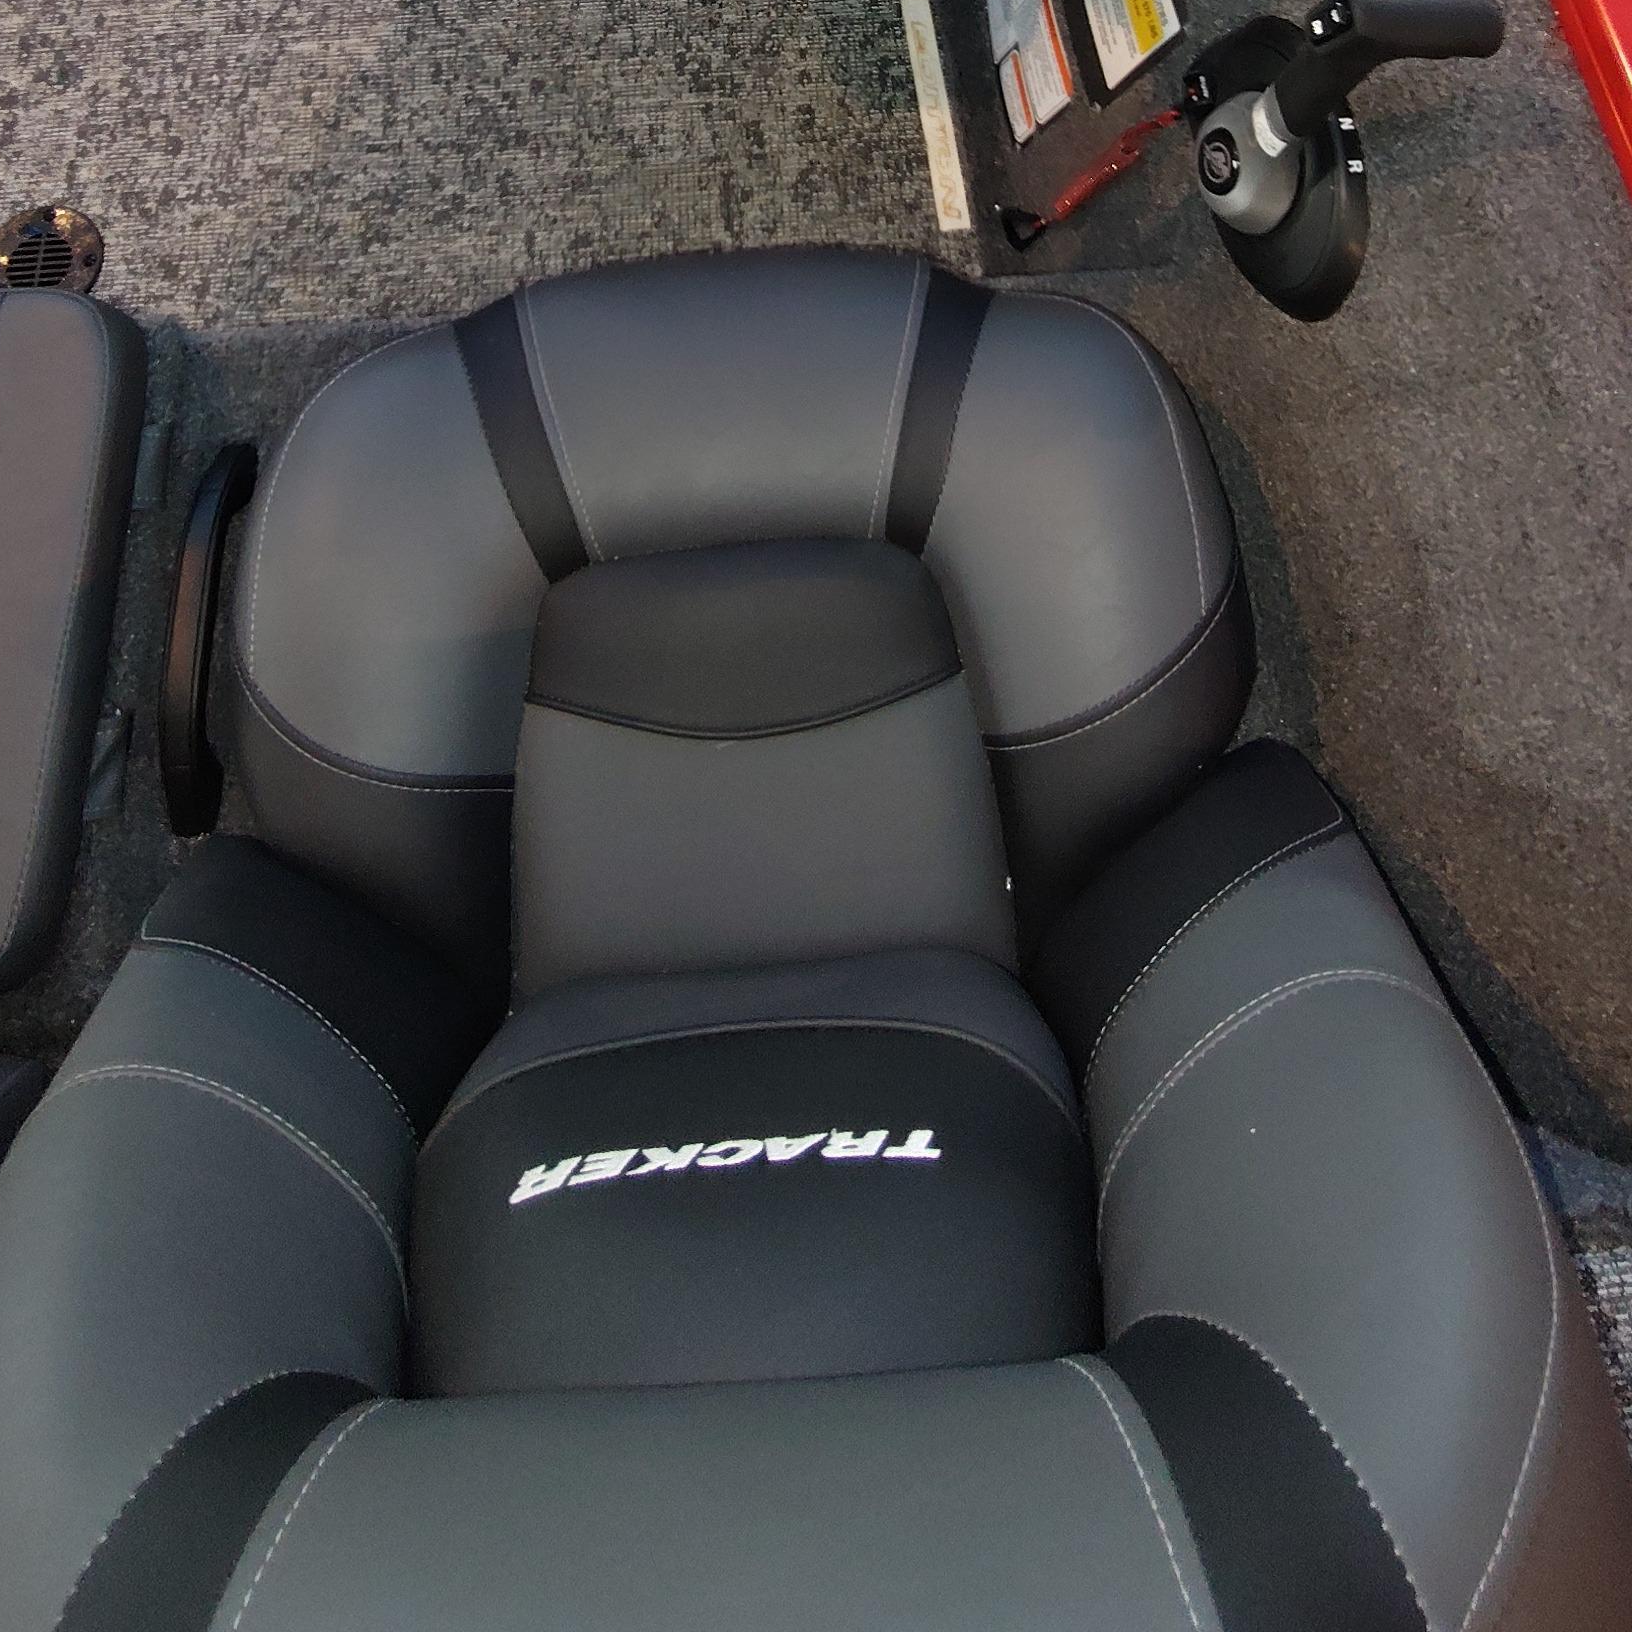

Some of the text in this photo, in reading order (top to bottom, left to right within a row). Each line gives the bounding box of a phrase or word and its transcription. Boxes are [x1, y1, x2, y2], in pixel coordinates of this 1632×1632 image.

[1337, 117, 1355, 131] N
[1347, 159, 1364, 174] R
[508, 1128, 942, 1205] TRACKER
